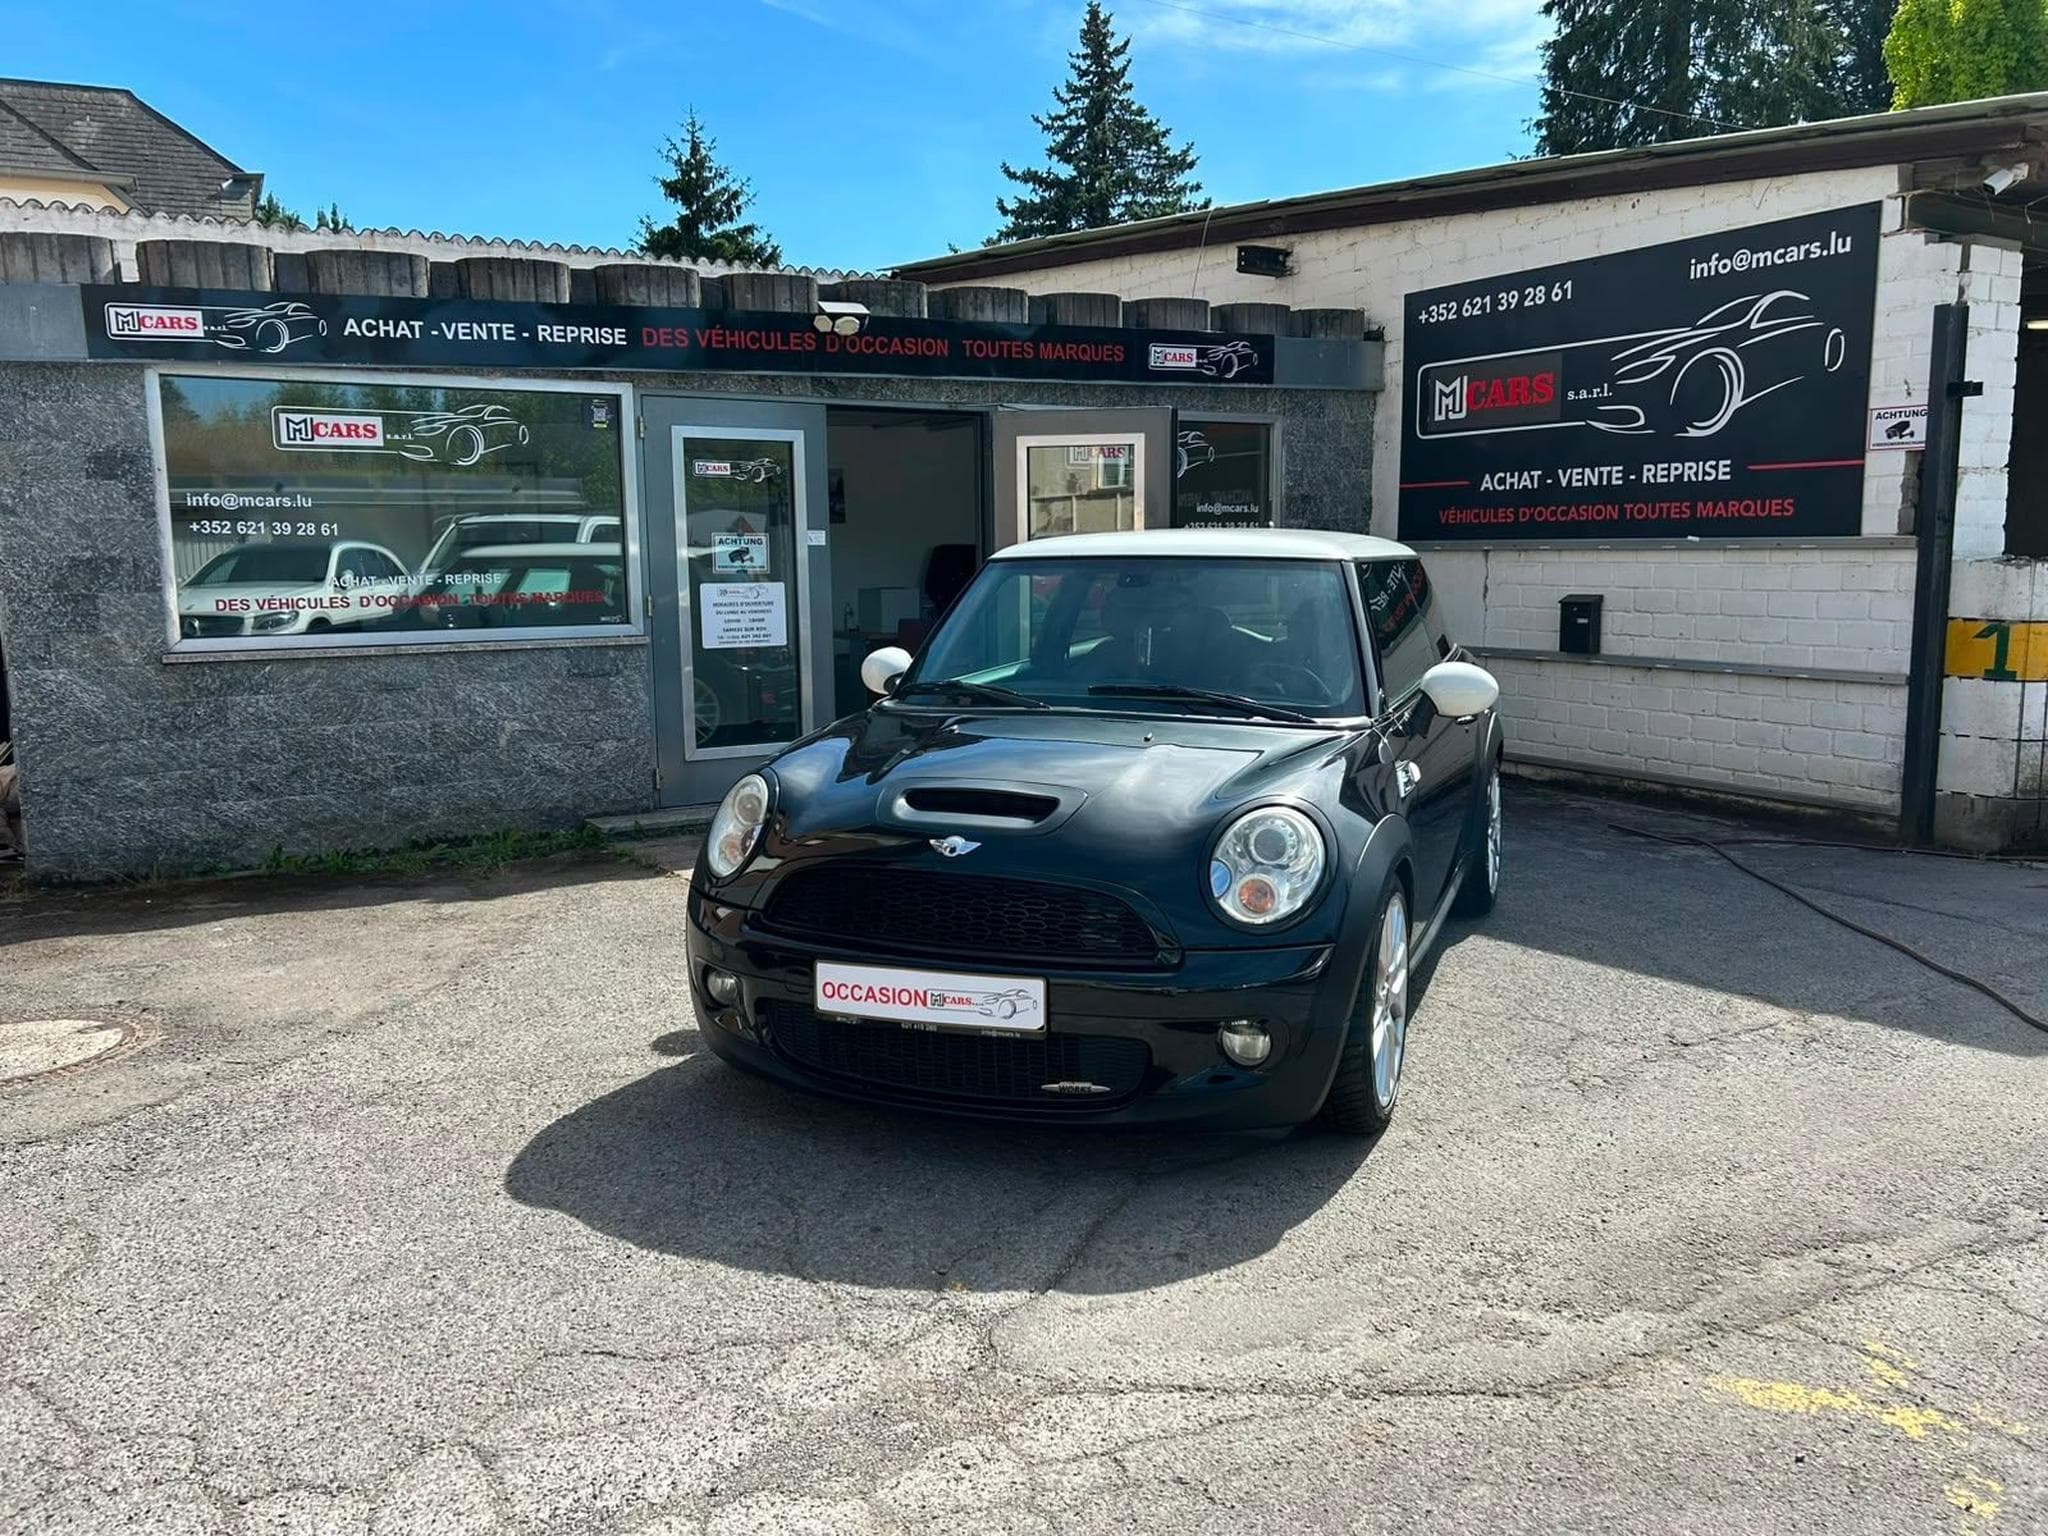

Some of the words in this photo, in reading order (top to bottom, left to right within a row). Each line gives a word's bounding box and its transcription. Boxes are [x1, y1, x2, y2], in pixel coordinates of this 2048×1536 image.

[1689, 231, 1852, 280] info@mcars.lu
[1418, 301, 1457, 324] +352
[1462, 295, 1491, 317] 621
[1498, 290, 1518, 312] 39
[1524, 285, 1546, 307] 28
[1551, 280, 1572, 301] 61
[343, 318, 424, 339] ACHAT
[440, 322, 516, 341] VENTE
[537, 325, 627, 345] REPRISE
[642, 327, 688, 347] DES
[696, 325, 816, 351] VÉHICULES
[826, 334, 949, 357] D'OCCASION
[962, 340, 1034, 359] TOUTES
[1039, 343, 1125, 362] MARQUES
[1567, 382, 1613, 400] s.a.r.l.
[1875, 409, 1928, 420] ACHTUNG
[1480, 470, 1542, 492] ACHAT
[1557, 465, 1623, 488] VENTE
[1642, 459, 1732, 484] REPRISE
[186, 493, 312, 510] info@mcars.lu
[1439, 505, 1514, 524] VÉHICULES
[1518, 503, 1618, 522] D'OCCASION
[1624, 501, 1691, 520] TOUTES
[1696, 499, 1795, 518] MARQUES
[189, 520, 231, 535] +352
[236, 521, 265, 535] 621
[272, 522, 291, 535] 39
[296, 522, 316, 536] 28
[320, 523, 339, 536] 61
[718, 537, 763, 546] ACHTUNG
[330, 575, 376, 587] ACHAT
[389, 574, 434, 587] VENTE
[445, 573, 502, 585] REPRISE
[215, 599, 251, 612] DES
[255, 595, 350, 611] VÉHICULES
[1973, 623, 2017, 681] 1
[822, 981, 928, 1007] OCCASION
